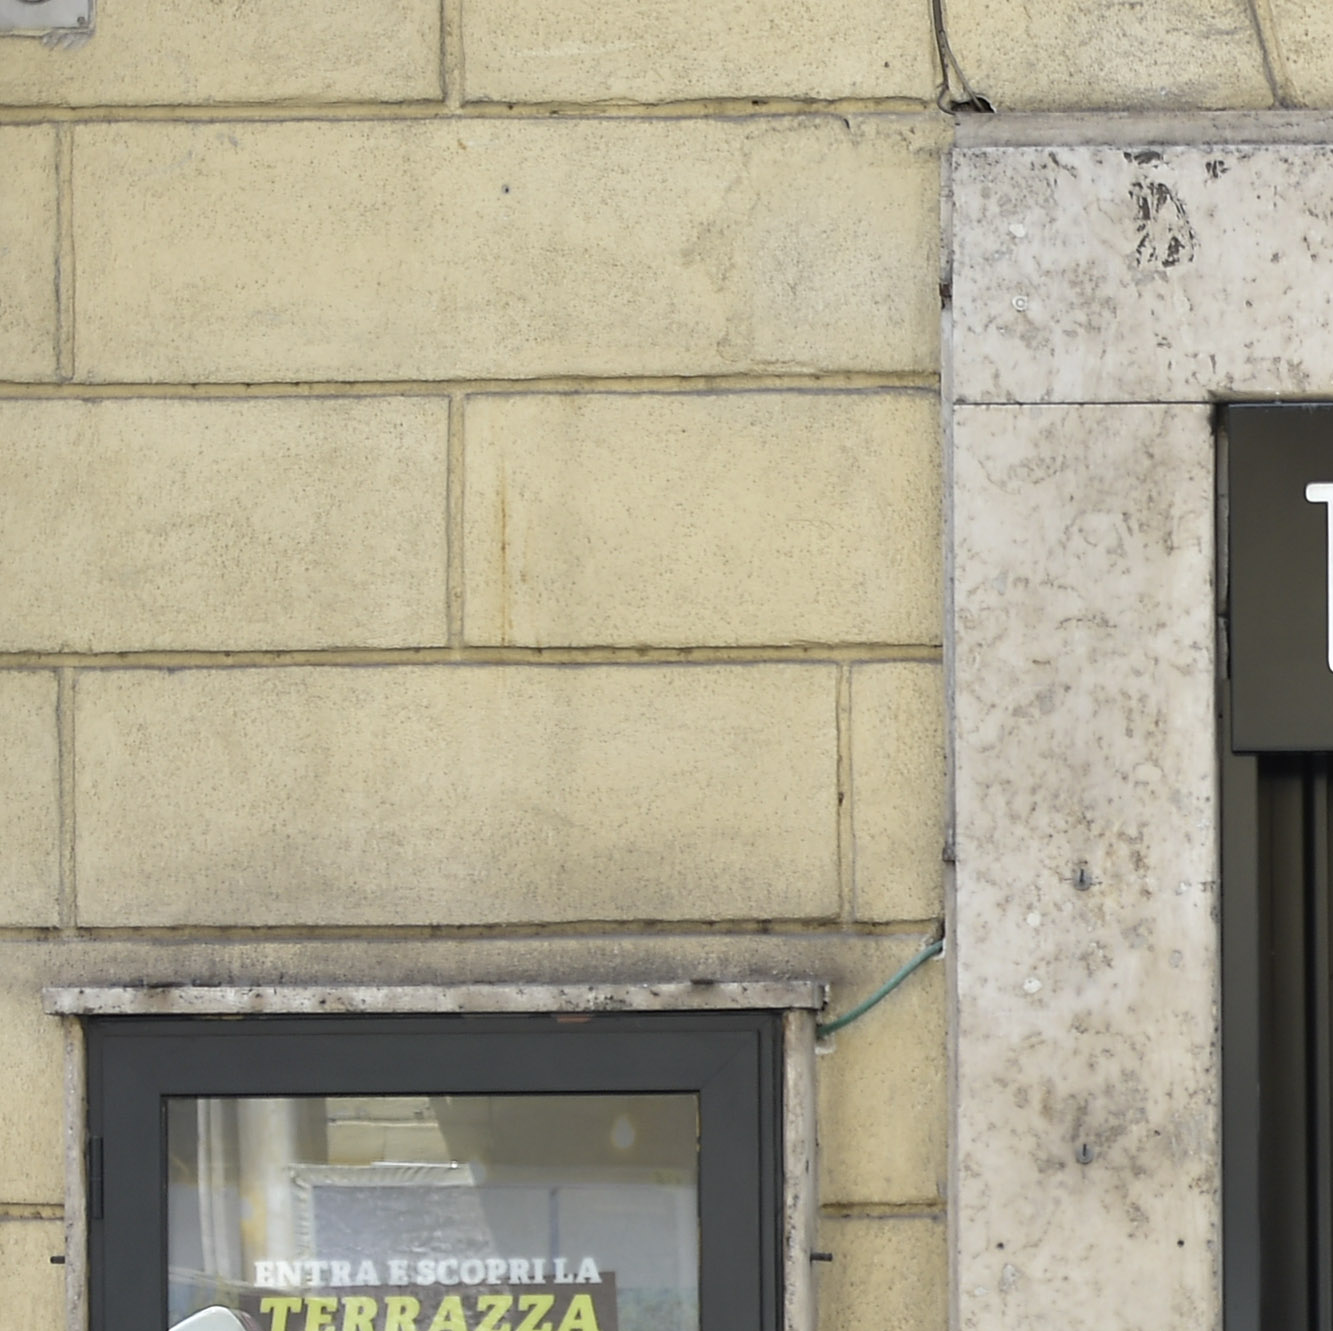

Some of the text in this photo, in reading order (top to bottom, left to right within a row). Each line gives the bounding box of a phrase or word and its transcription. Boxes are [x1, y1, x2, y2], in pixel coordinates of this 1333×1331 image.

[254, 1257, 602, 1287] ENTRA E SCOPRI LA
